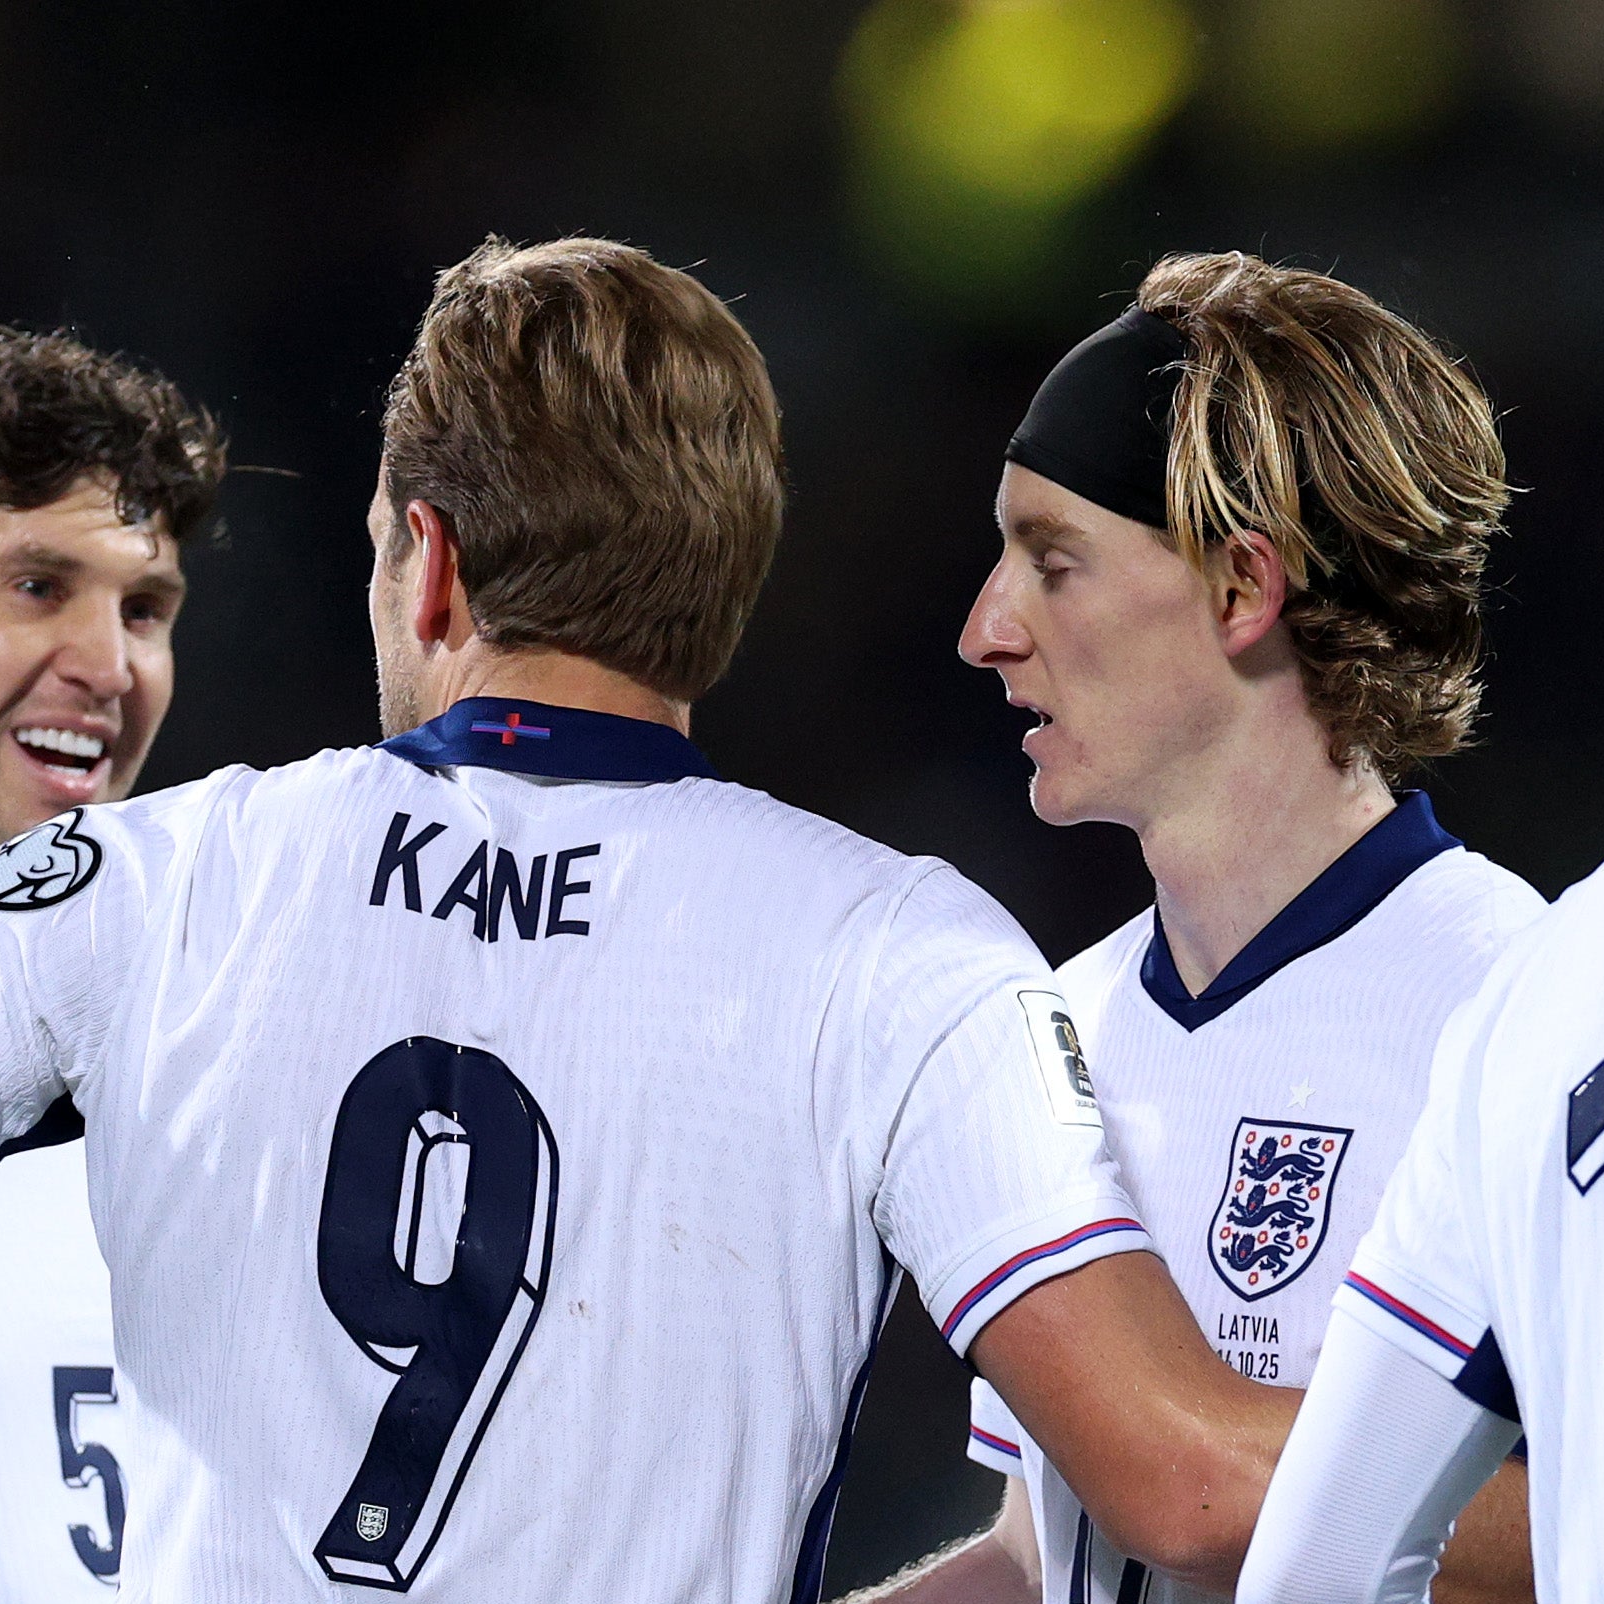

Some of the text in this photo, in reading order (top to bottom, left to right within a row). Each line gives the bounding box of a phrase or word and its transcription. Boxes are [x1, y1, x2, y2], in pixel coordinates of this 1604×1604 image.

[369, 811, 601, 943] KANE
[313, 1035, 560, 1593] 9
[1217, 1349, 1279, 1379] 10.25
[1218, 1312, 1279, 1345] LATVIA
[53, 1365, 129, 1593] 5
